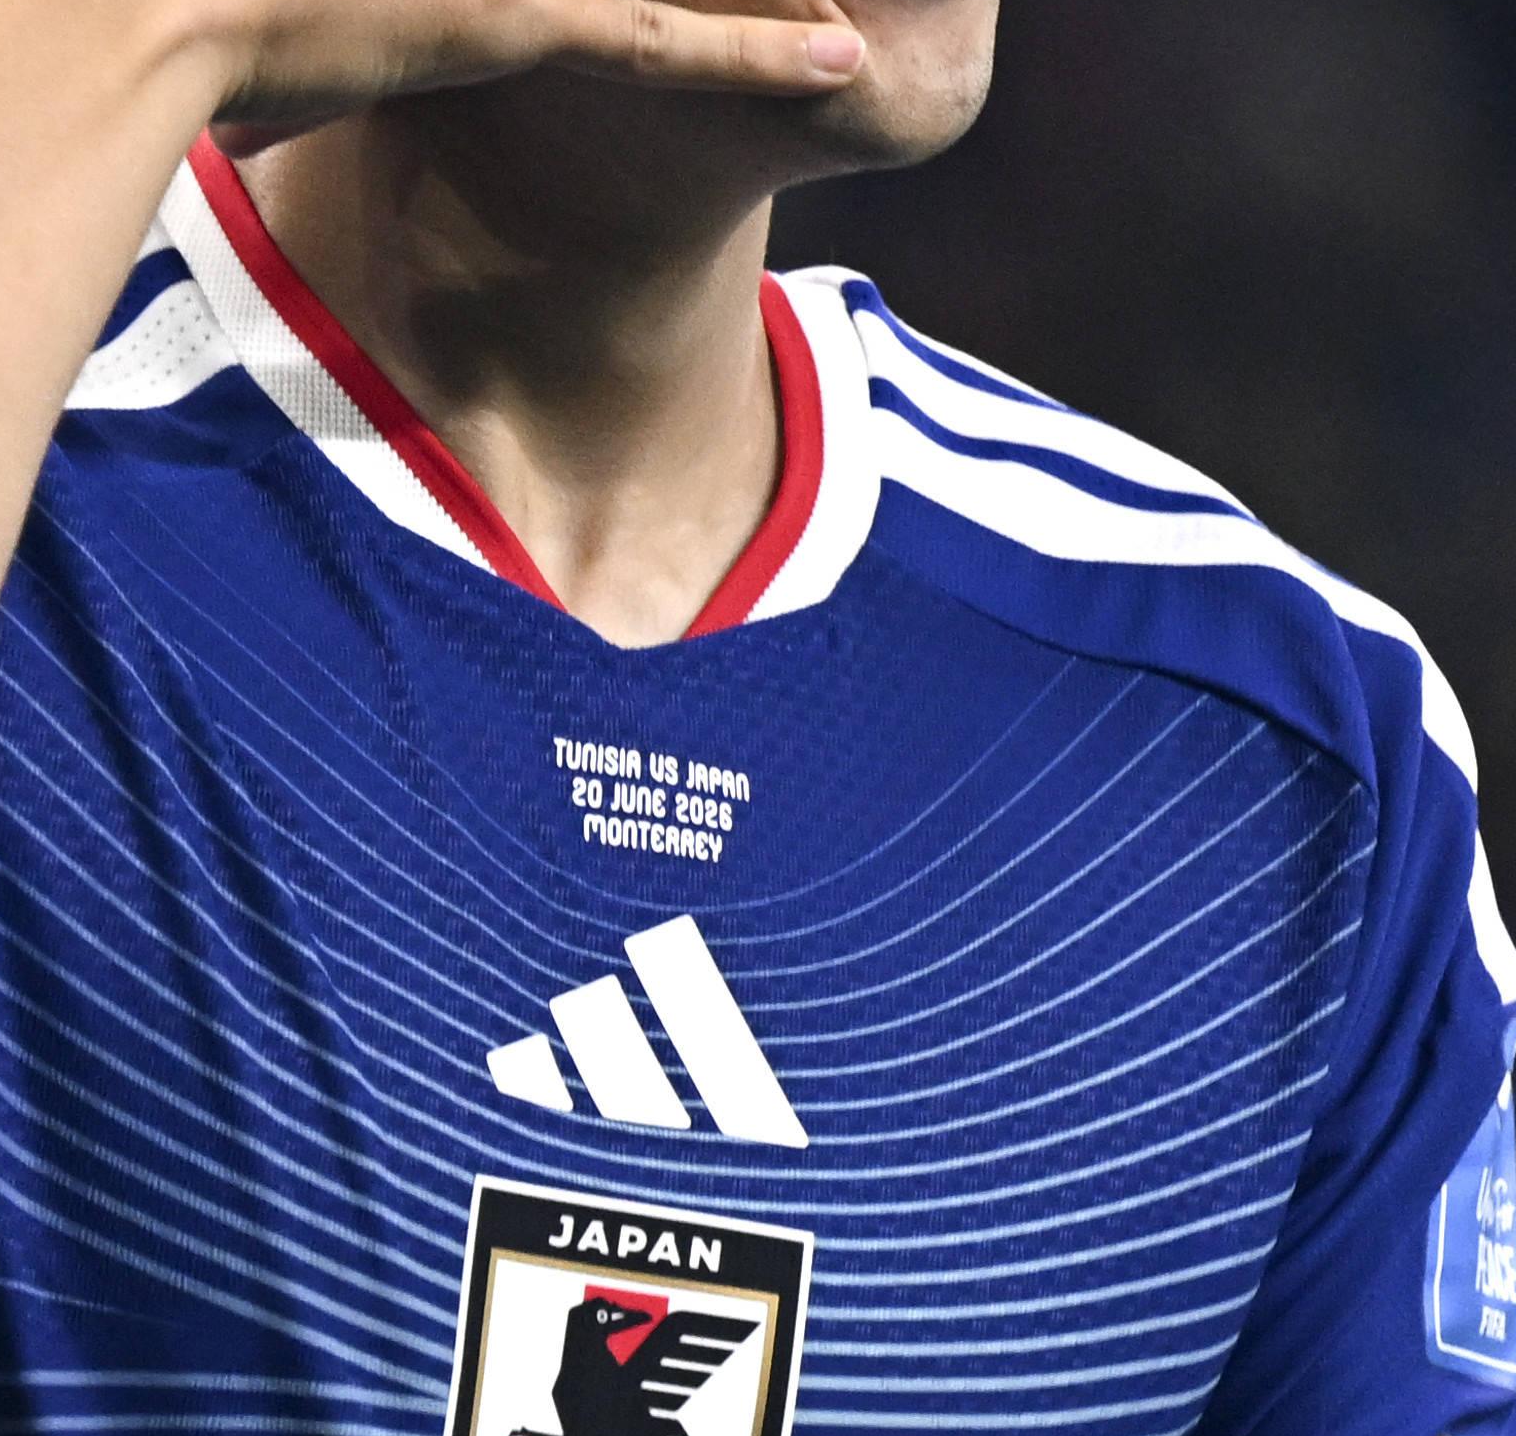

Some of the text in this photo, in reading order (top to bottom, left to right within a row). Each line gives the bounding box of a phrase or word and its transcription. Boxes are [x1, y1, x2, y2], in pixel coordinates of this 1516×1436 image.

[553, 736, 642, 780] TUNISIA
[686, 760, 750, 803] JAPAN
[572, 776, 733, 832] 20 JUNE 2026
[583, 813, 723, 863] MONTERREY
[548, 1214, 723, 1274] JAPAN
